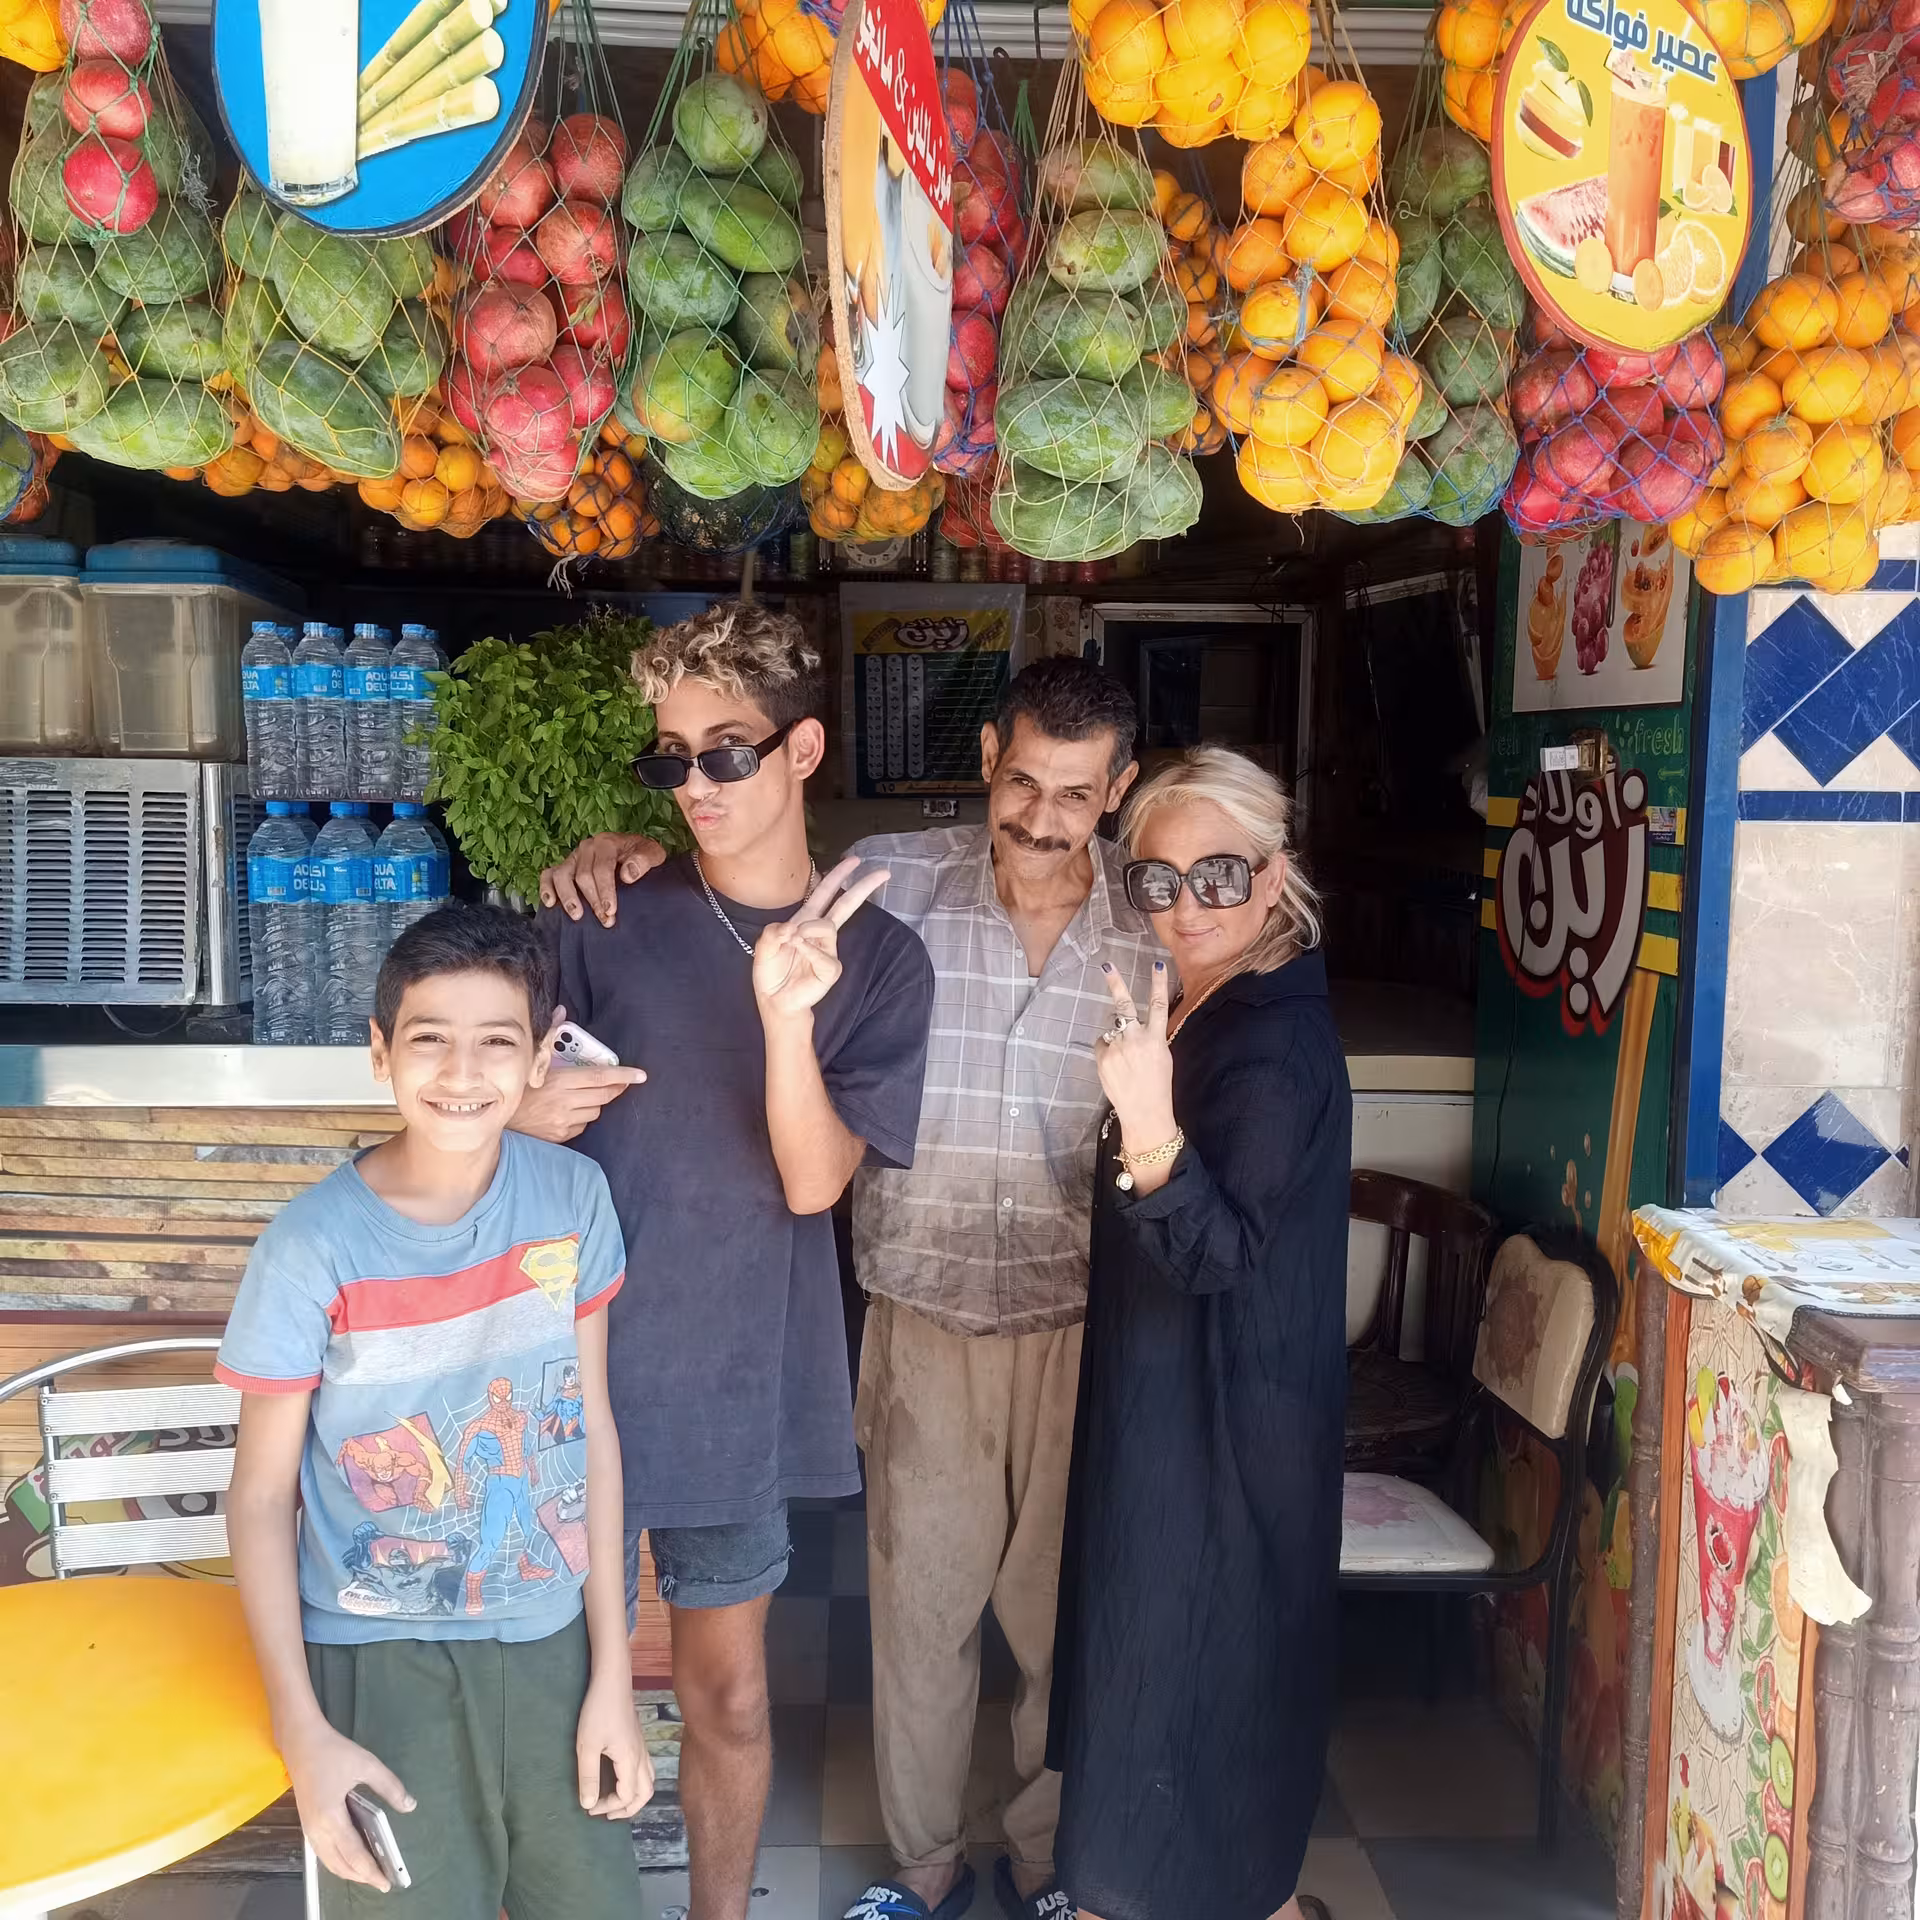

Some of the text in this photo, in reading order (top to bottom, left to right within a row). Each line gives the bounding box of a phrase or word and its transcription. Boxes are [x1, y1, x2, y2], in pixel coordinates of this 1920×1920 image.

[1652, 29, 1717, 82] عصير
[894, 48, 909, 124] &
[1634, 713, 1685, 756] fresh
[374, 863, 395, 876] QUA
[374, 878, 397, 891] ELTA
[1503, 775, 1645, 1015] زين
[861, 1886, 902, 1904] JUST
[1036, 1890, 1069, 1917] JUS
